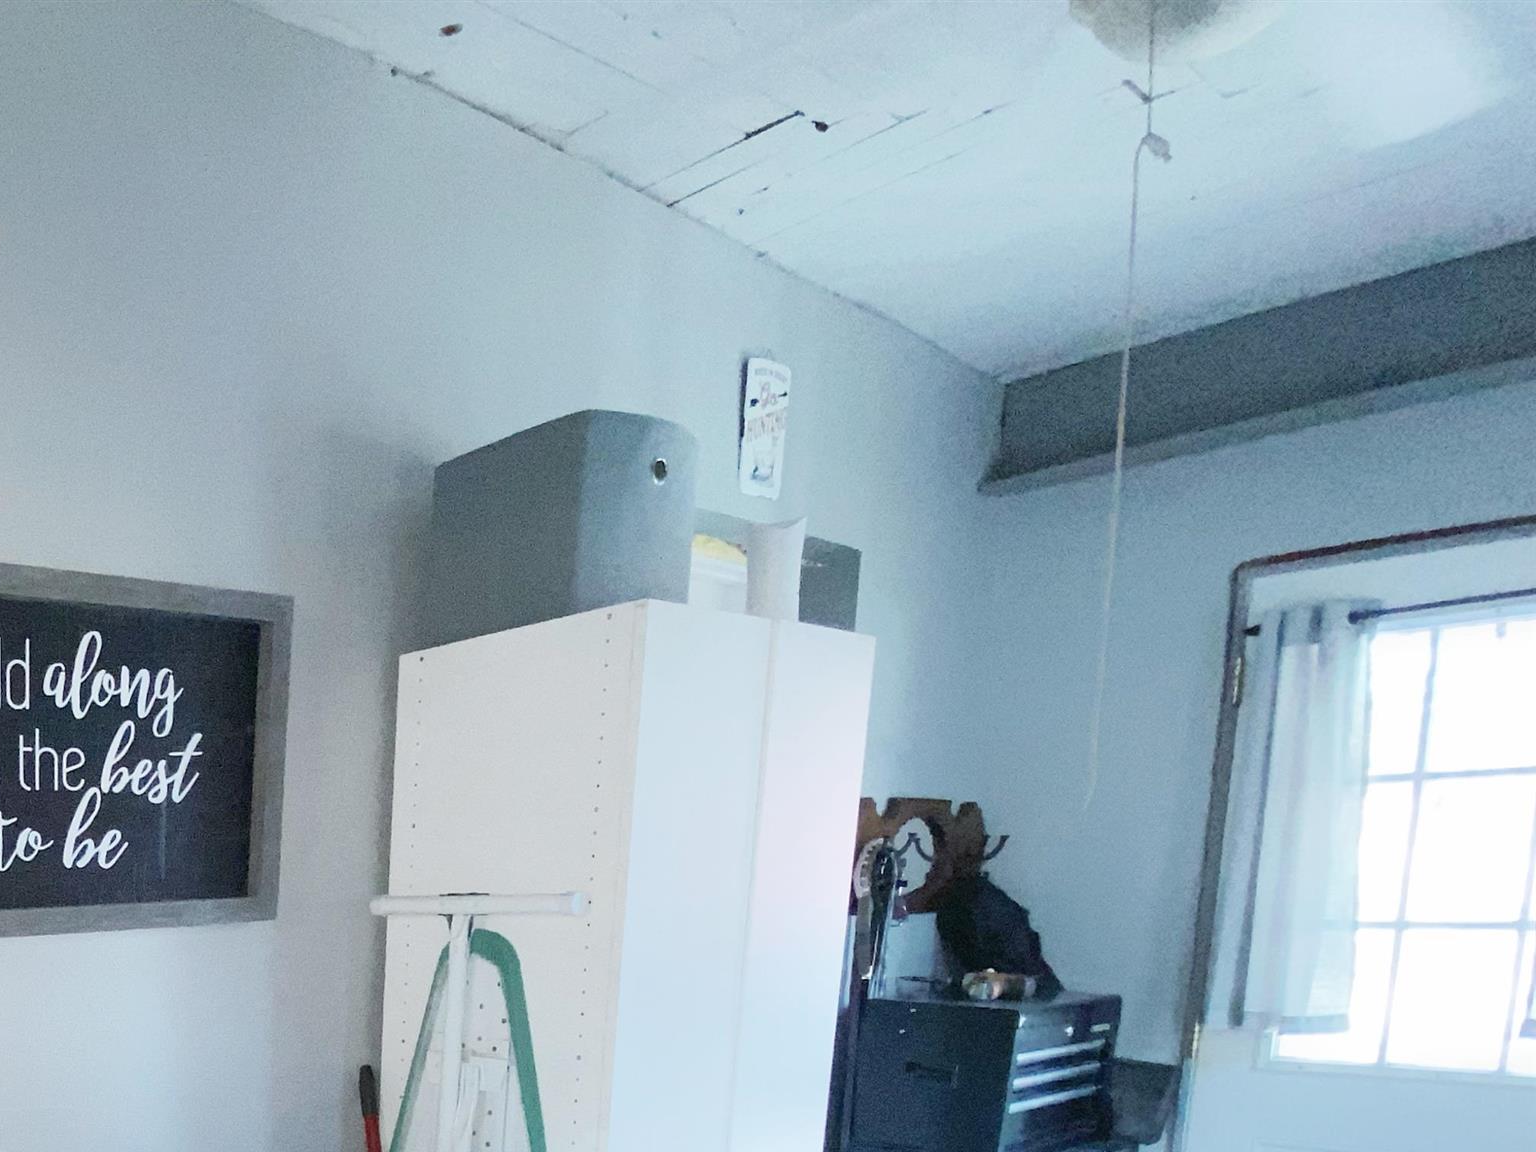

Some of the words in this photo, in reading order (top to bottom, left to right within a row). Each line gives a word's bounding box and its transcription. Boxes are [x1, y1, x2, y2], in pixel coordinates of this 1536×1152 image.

[42, 630, 184, 738] along
[19, 727, 86, 791] the
[100, 719, 203, 804] best
[62, 786, 129, 870] be
